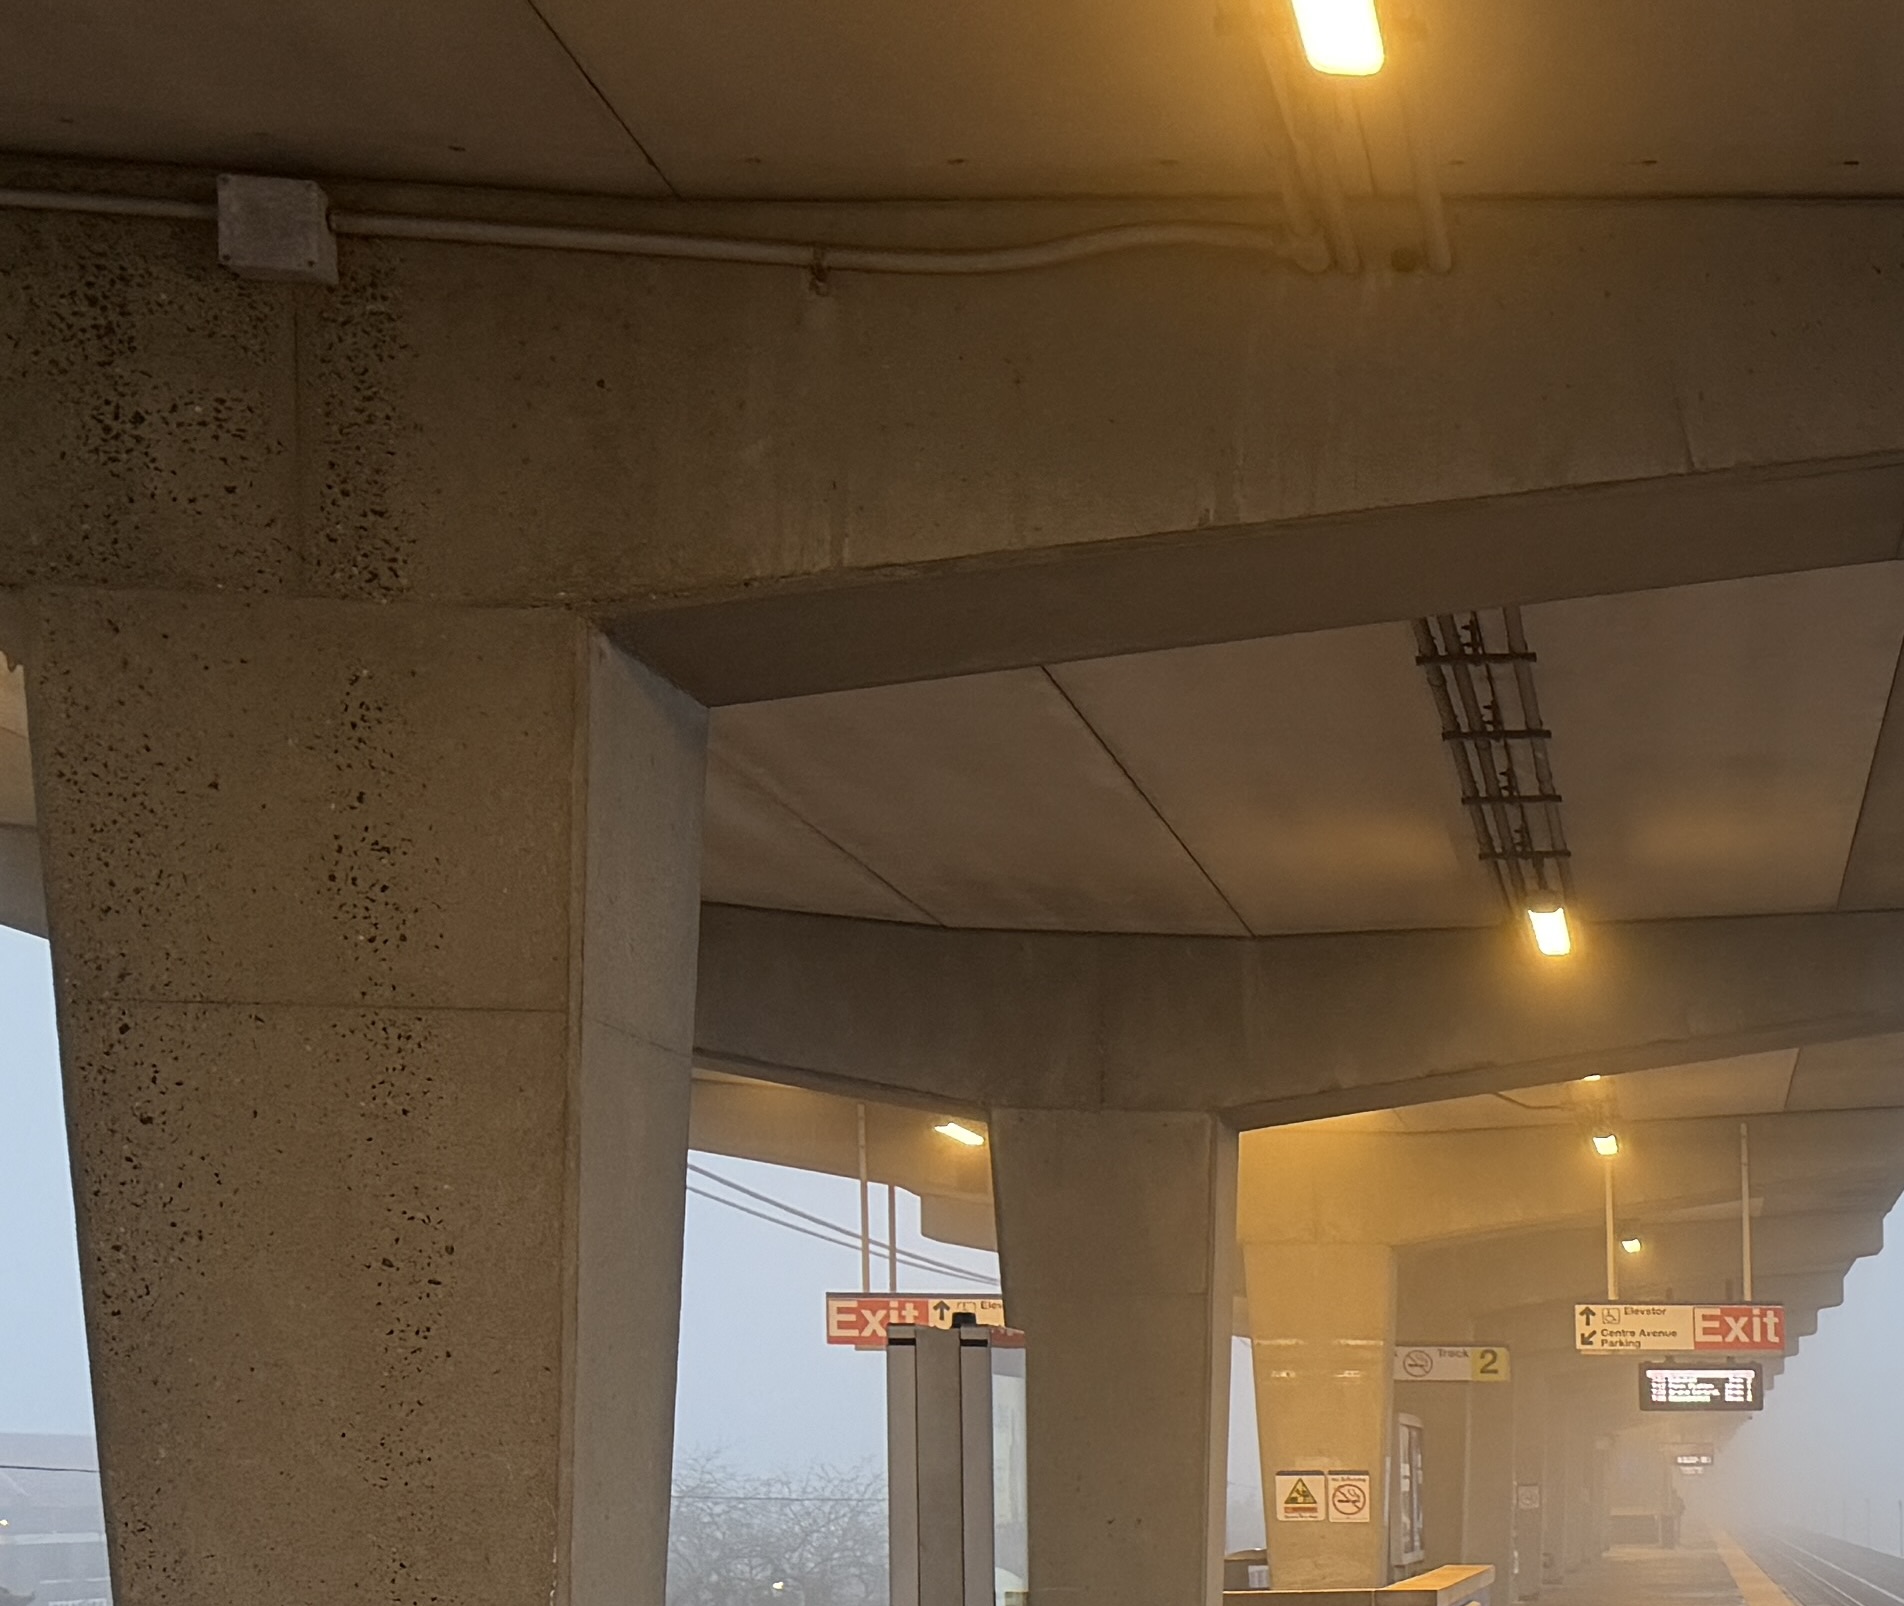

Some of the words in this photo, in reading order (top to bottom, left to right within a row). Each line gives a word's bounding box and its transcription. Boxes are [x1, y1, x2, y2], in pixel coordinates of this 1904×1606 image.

[828, 1300, 919, 1337] Exit
[1624, 1306, 1667, 1316] Elevator
[1600, 1328, 1636, 1338] Centre
[1638, 1328, 1678, 1338] Avenue
[1695, 1307, 1780, 1343] Exit
[1600, 1338, 1641, 1349] Parking
[1437, 1348, 1469, 1358] Track
[1480, 1349, 1499, 1374] 2
